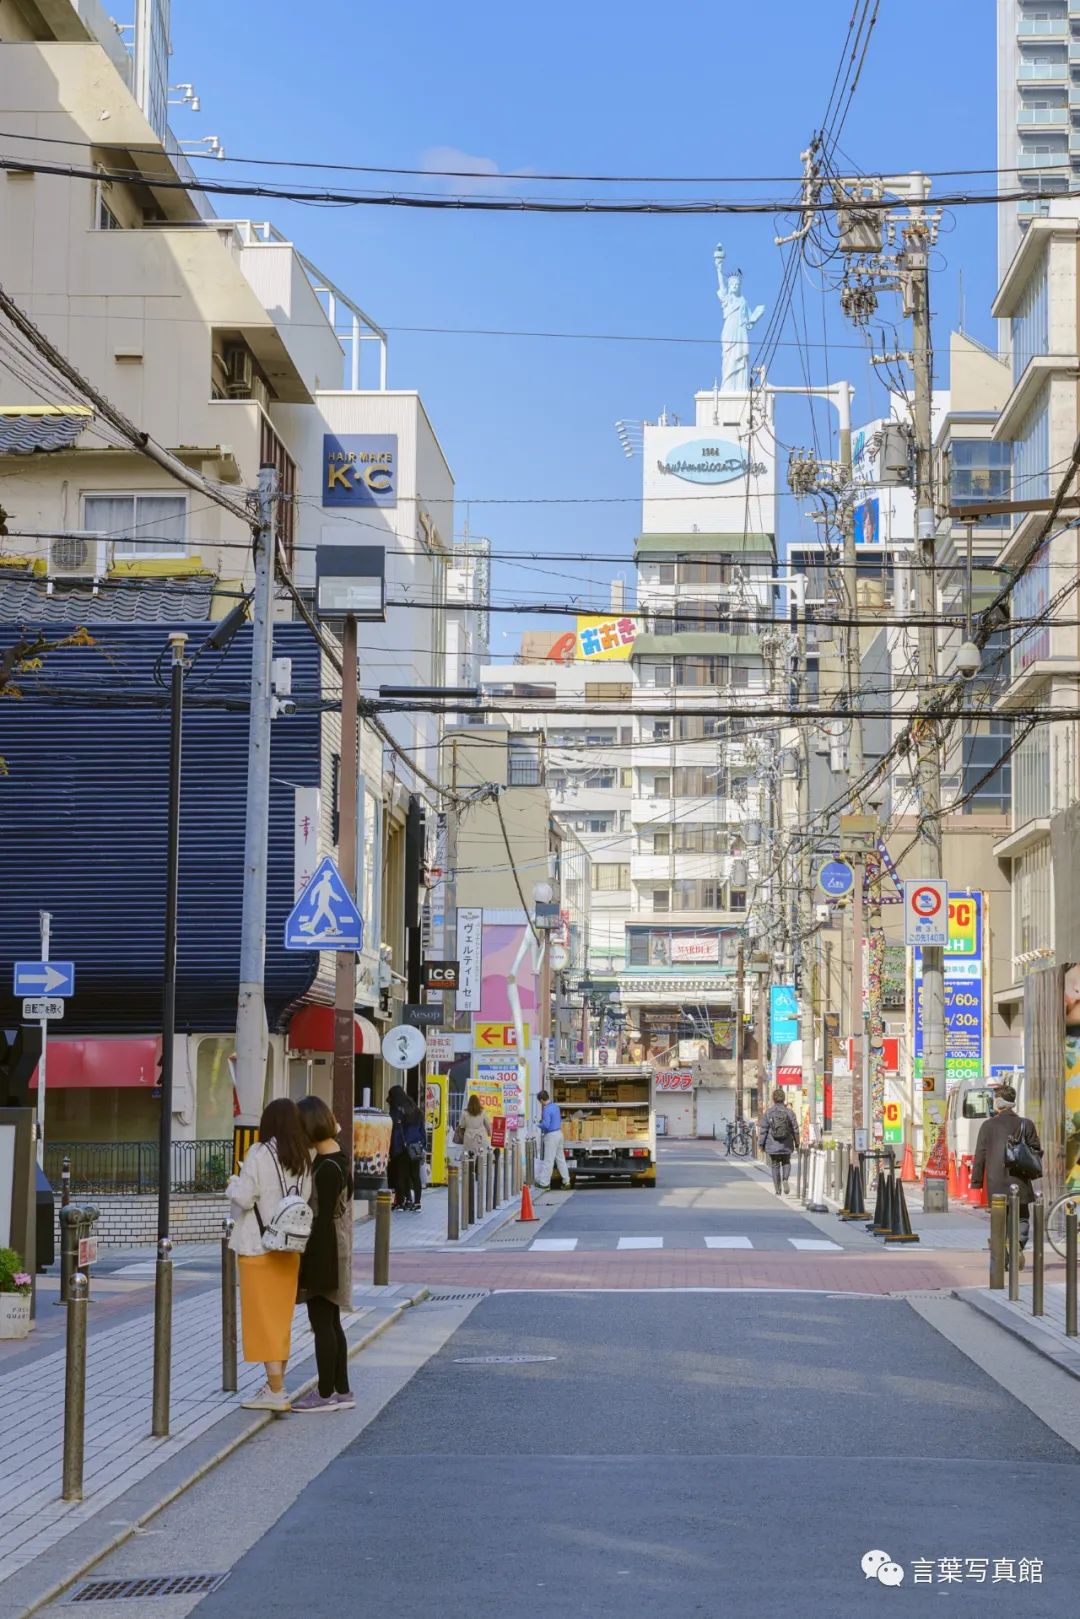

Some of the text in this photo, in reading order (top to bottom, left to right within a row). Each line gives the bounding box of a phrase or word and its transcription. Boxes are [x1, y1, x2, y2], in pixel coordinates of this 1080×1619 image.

[328, 451, 392, 463] HAIR MAKE
[428, 969, 456, 980] ice
[409, 1009, 440, 1020] Aesop
